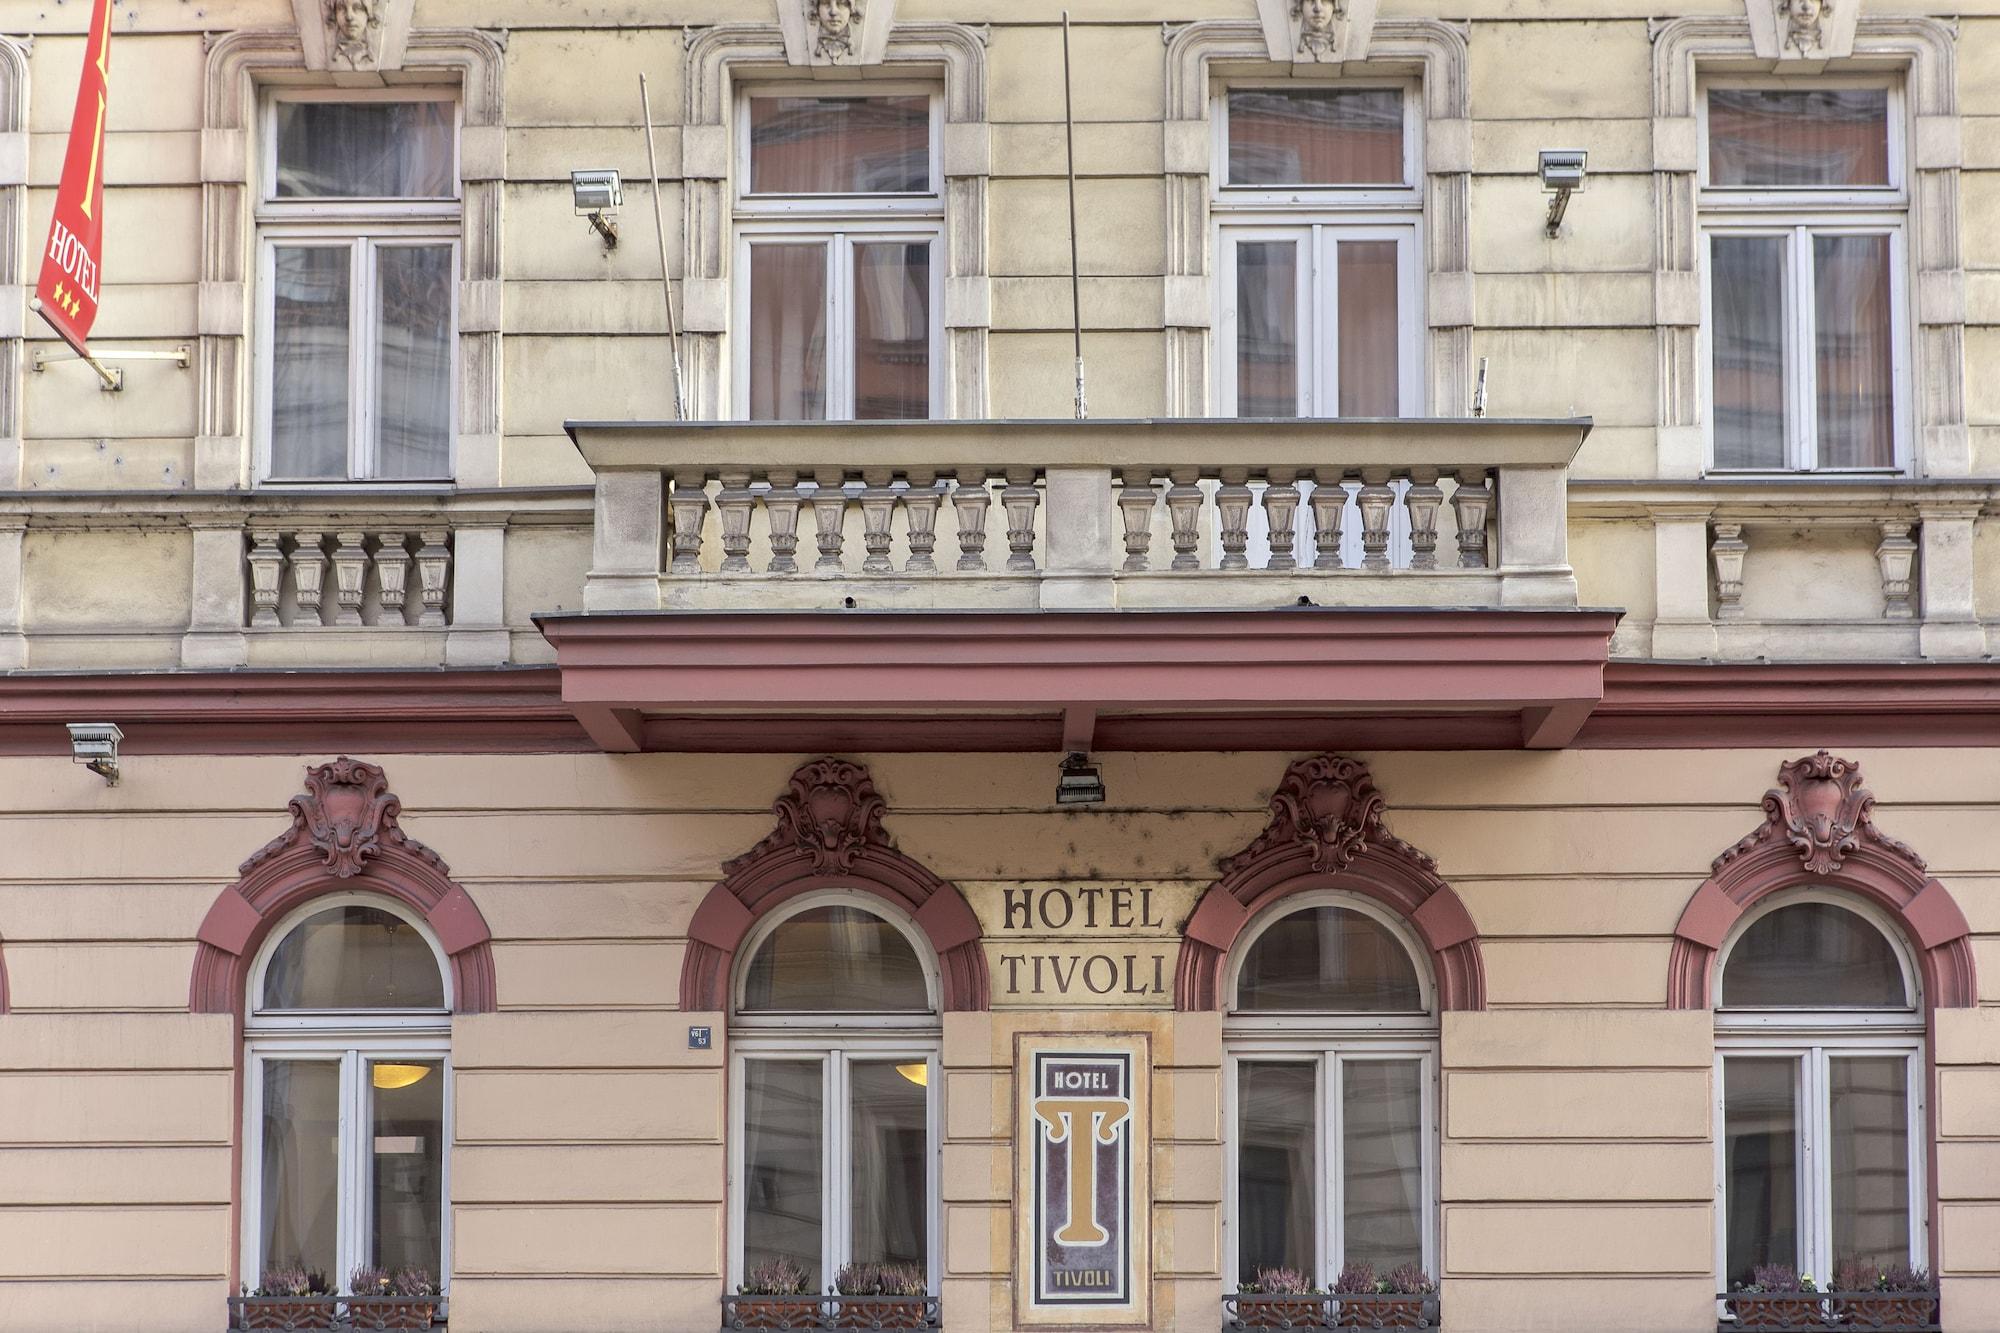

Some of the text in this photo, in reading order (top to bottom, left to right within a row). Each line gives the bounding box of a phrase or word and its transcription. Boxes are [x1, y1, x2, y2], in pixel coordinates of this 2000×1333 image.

[49, 219, 98, 305] HOTEL
[1003, 887, 1163, 929] HOTEL
[1000, 954, 1165, 995] TIVOLI
[1054, 1071, 1109, 1089] HOTEL
[1053, 1270, 1110, 1288] TIVOLI
